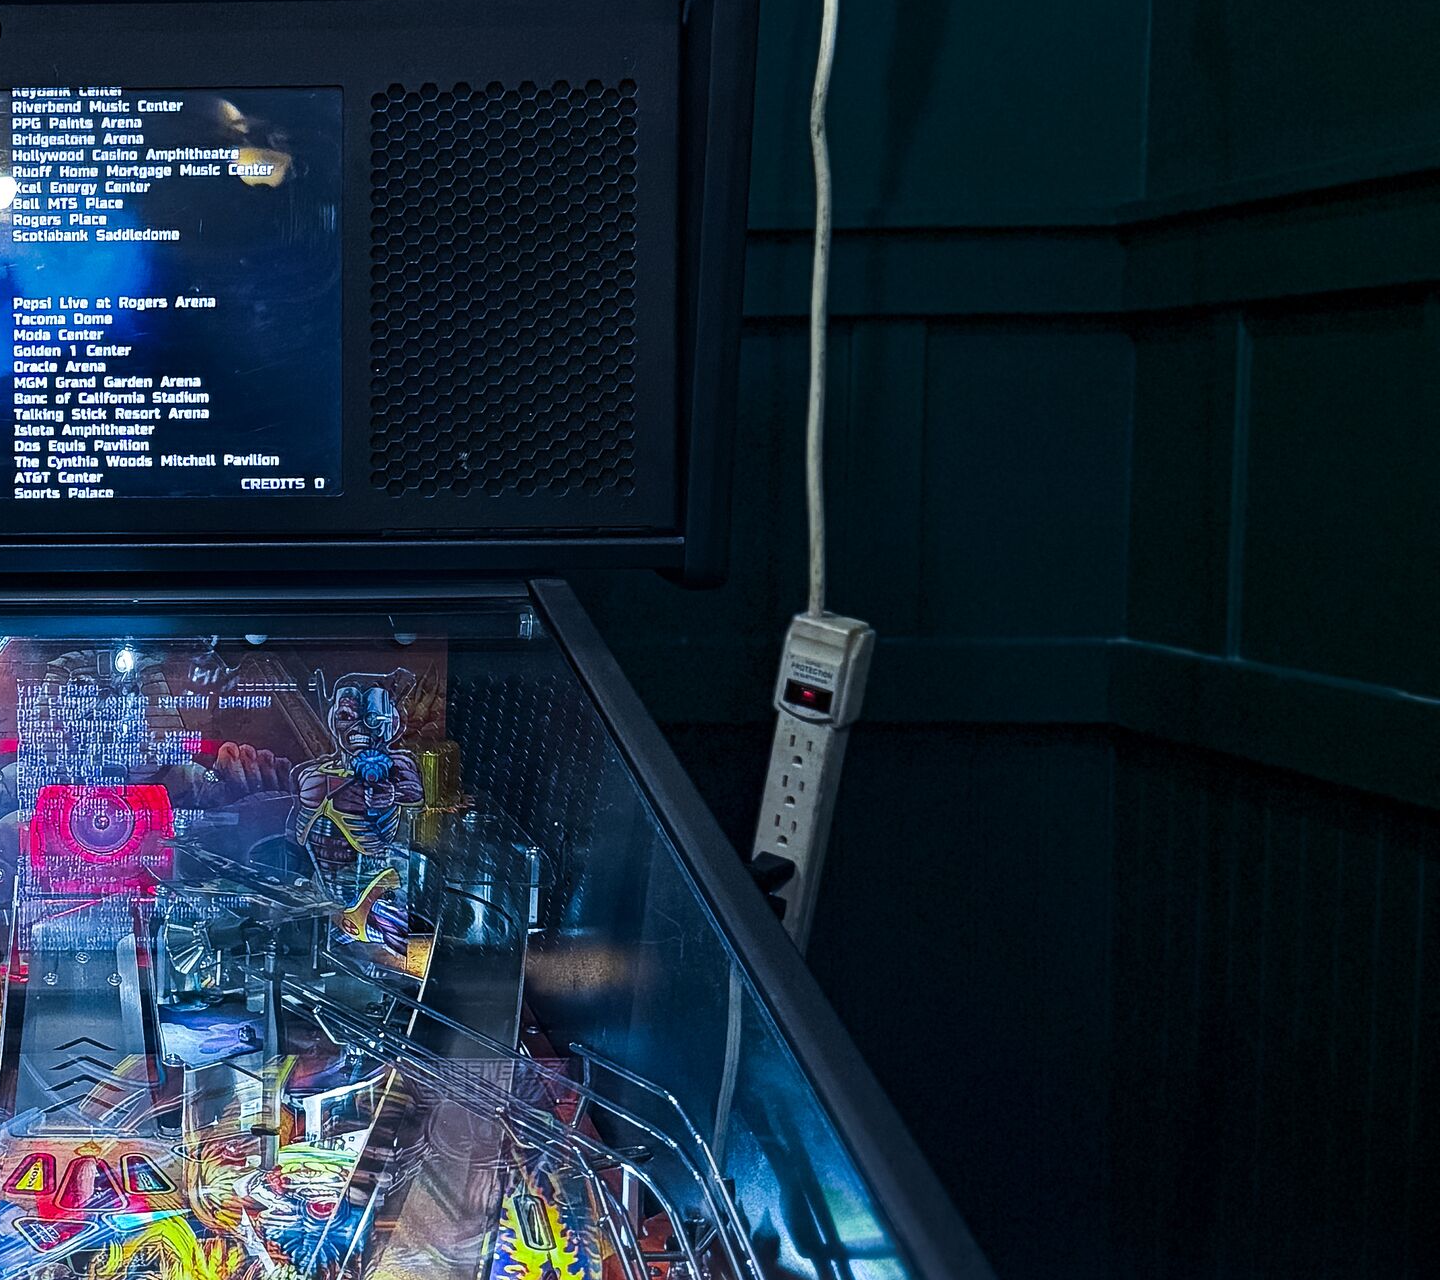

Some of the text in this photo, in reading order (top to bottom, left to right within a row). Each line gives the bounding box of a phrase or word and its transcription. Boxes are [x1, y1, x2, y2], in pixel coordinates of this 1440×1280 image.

[13, 116, 142, 129] PPG Paints Arena
[13, 133, 144, 147] Bridgestone Arena
[13, 214, 106, 228] Rogers Place
[13, 313, 112, 325] Tacoma Dome
[14, 329, 103, 341] Moda Center
[14, 345, 131, 356] Golden 1 Center
[14, 361, 106, 373] Oracle Arena
[14, 376, 201, 388] MGM Grand Garden Arena
[14, 391, 209, 404] Banc of California Stadium
[14, 423, 155, 437] Isleta Amphitheater
[15, 439, 149, 454] Dos Equis Pavilion
[14, 454, 279, 469] The Cynthia Woods Mitchell Pavilion
[15, 471, 103, 483] AT&T Center
[241, 477, 325, 490] CREDITS 0
